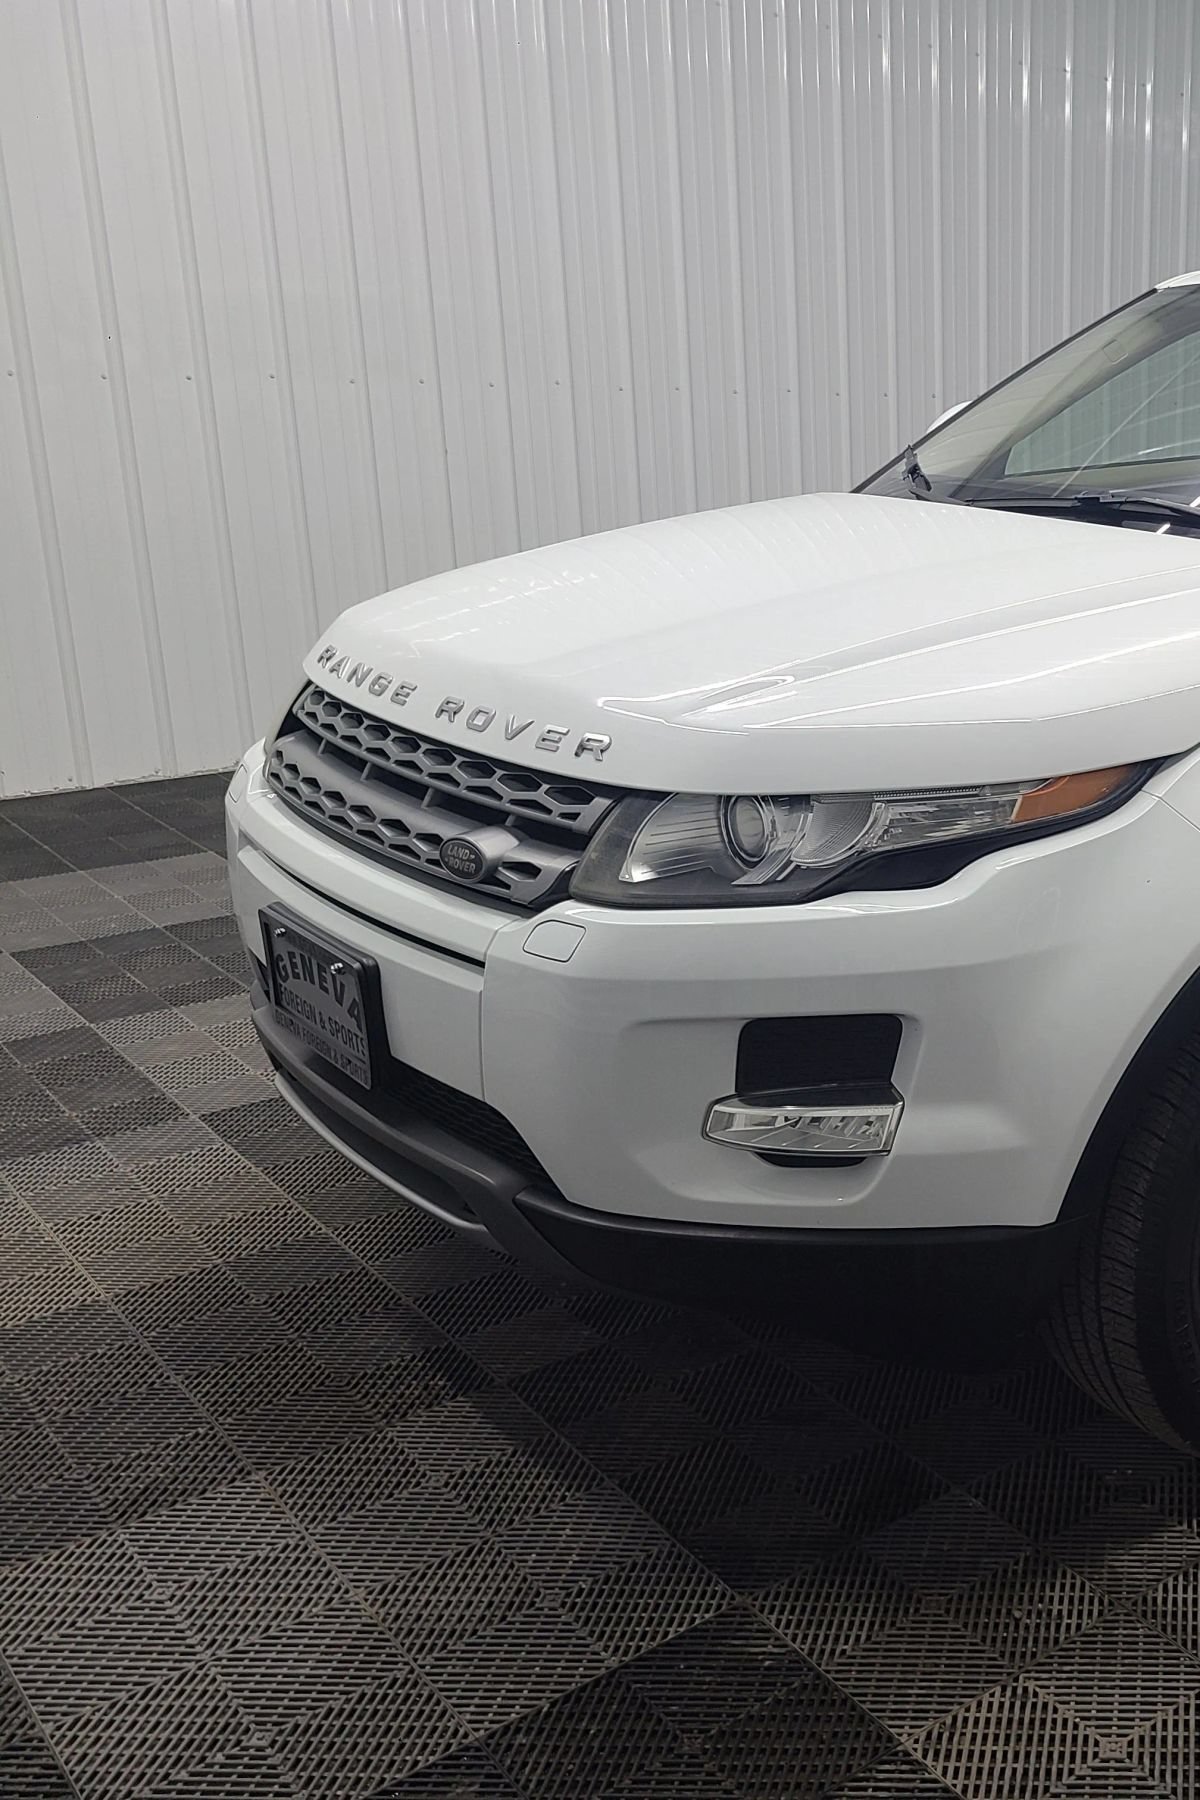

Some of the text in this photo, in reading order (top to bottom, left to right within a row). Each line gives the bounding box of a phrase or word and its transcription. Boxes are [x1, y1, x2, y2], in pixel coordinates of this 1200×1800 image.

[316, 644, 613, 762] RANGE ROVER
[447, 844, 471, 860] LAND
[448, 856, 476, 874] ROVER
[275, 950, 364, 1034] GENEVA
[279, 982, 367, 1057] FOREIGN & SPORTS
